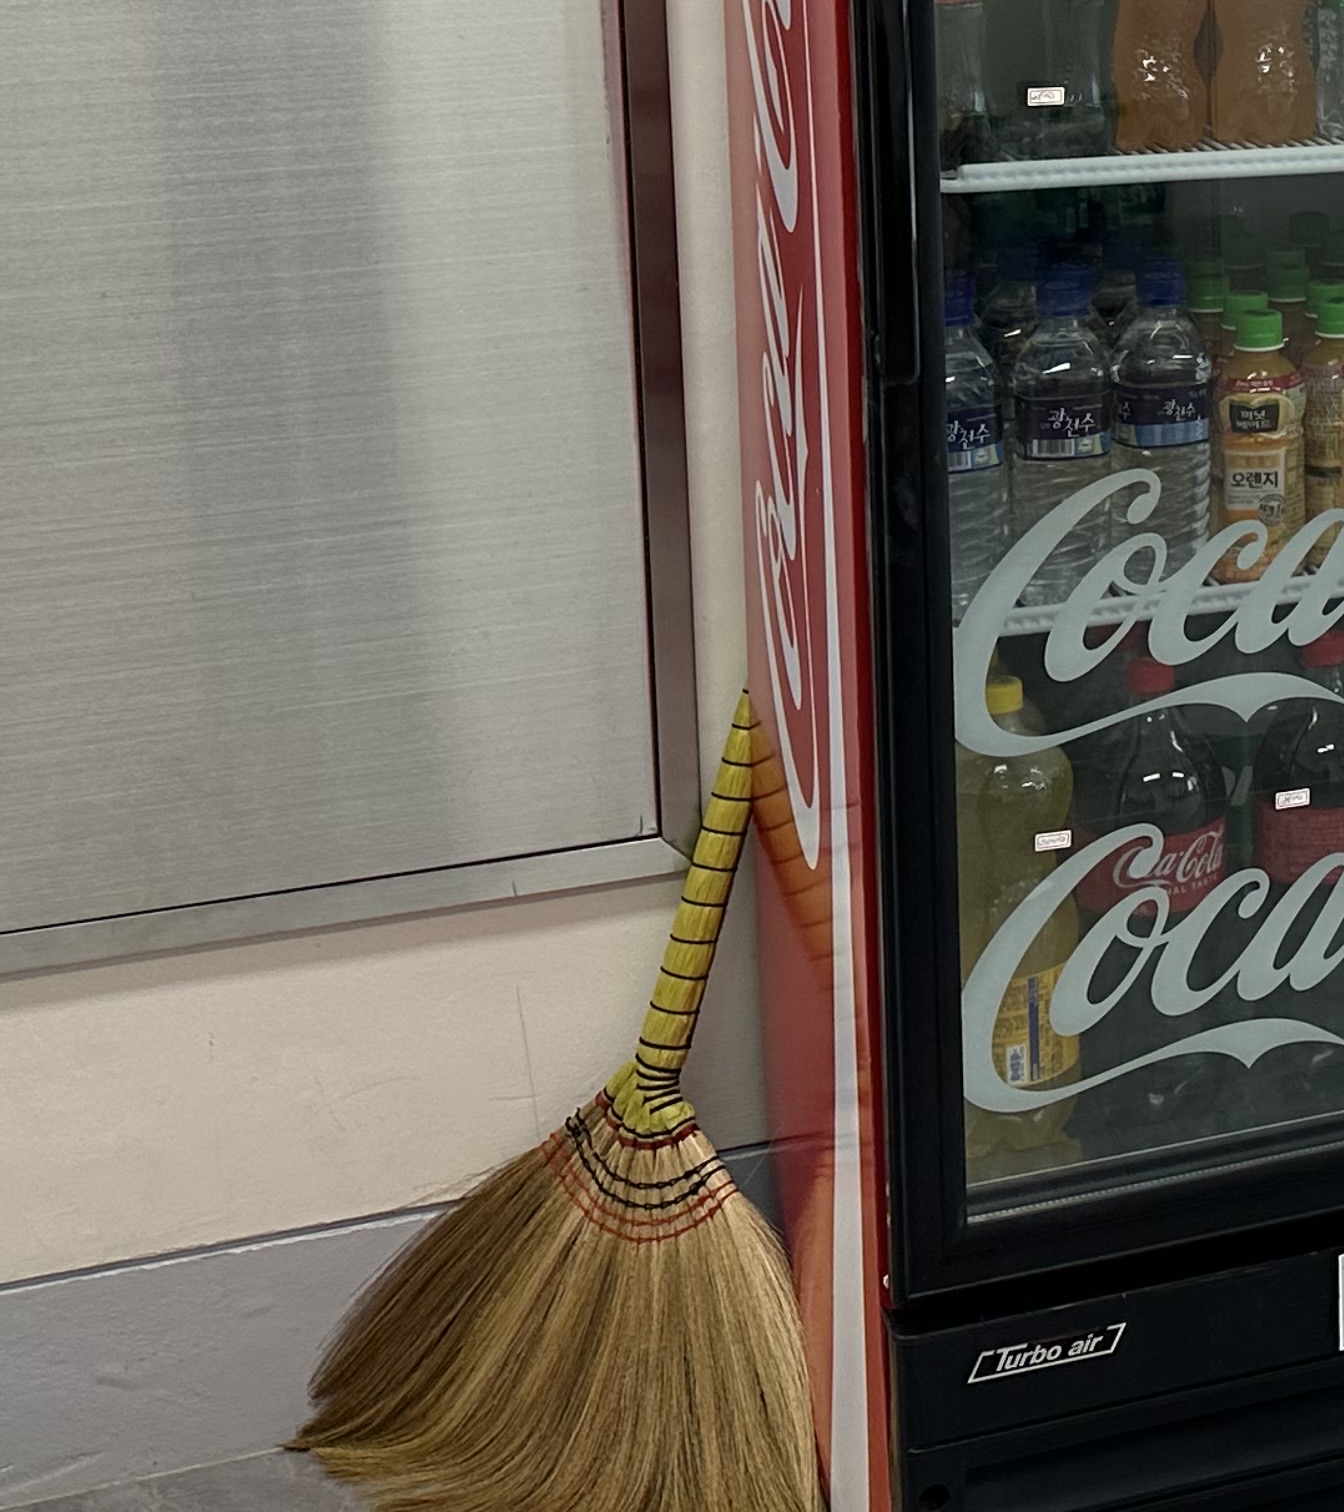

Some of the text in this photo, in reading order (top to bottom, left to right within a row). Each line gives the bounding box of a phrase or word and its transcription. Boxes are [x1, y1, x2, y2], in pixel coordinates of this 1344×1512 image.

[1232, 471, 1279, 489] 오렌지
[994, 1329, 1104, 1374] Turbo air
